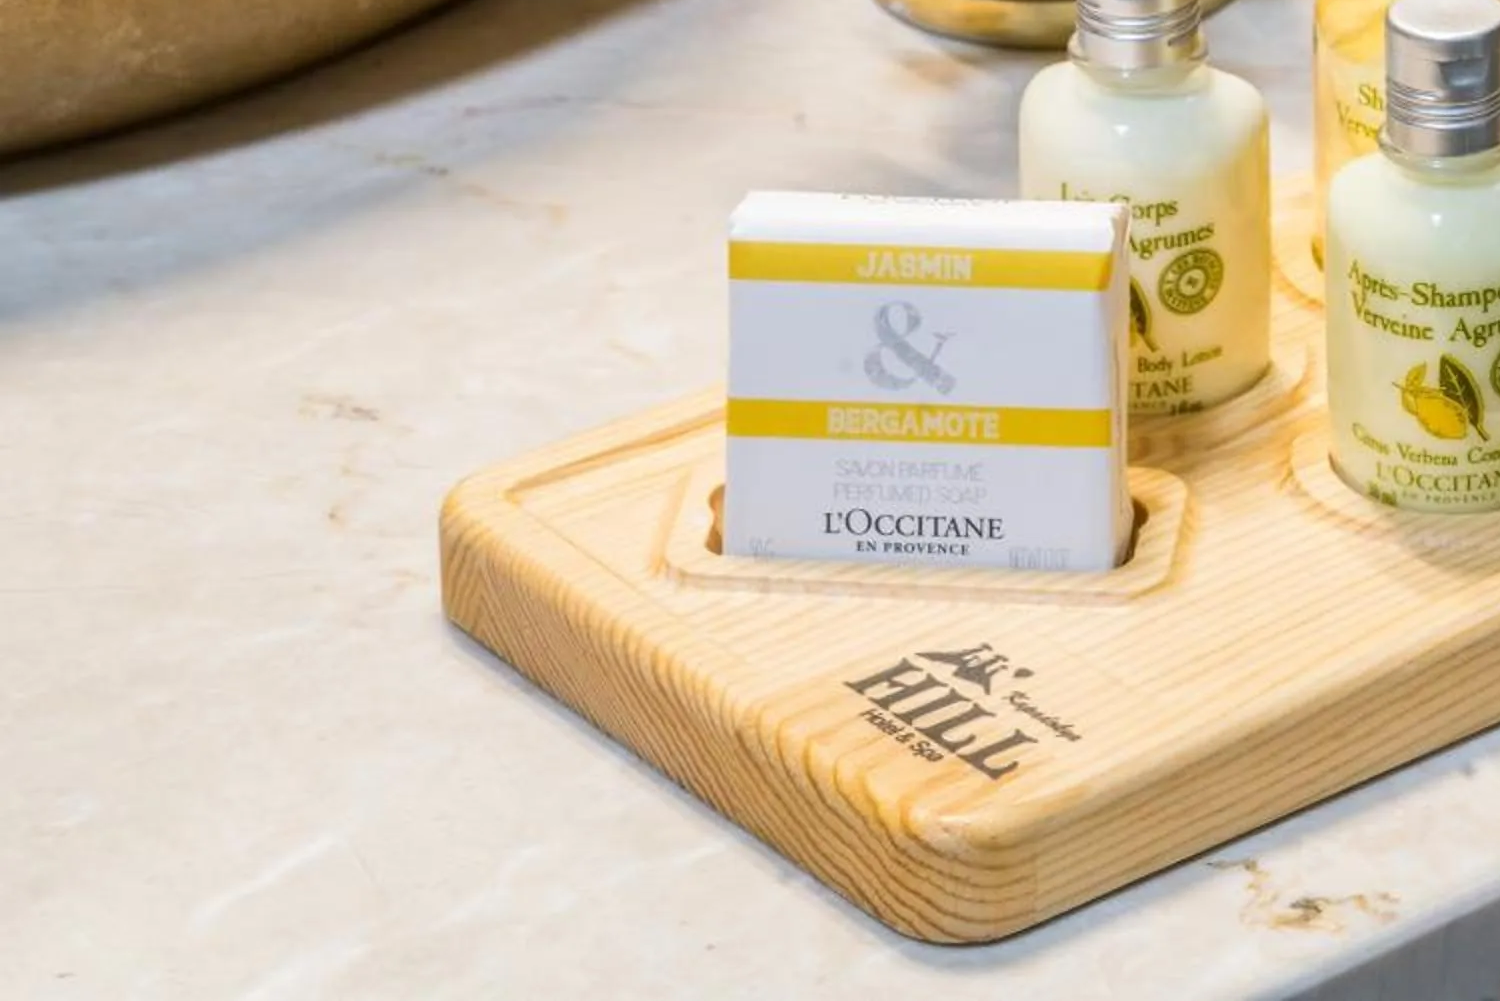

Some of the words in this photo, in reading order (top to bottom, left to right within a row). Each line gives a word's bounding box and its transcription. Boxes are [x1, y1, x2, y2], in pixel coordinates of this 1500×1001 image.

[856, 250, 974, 281] JASMIN
[1352, 291, 1434, 341] Verveine
[863, 300, 957, 395] &
[827, 406, 1000, 440] BERGAMOTE
[1396, 441, 1459, 467] Verbena
[824, 507, 1004, 540] L'OCCITANE
[857, 540, 878, 553] EN
[883, 542, 971, 556] PROVENCE
[843, 657, 1040, 781] HILL
[857, 707, 906, 737] Hotel
[895, 731, 915, 743] &
[908, 740, 945, 762] Spa
